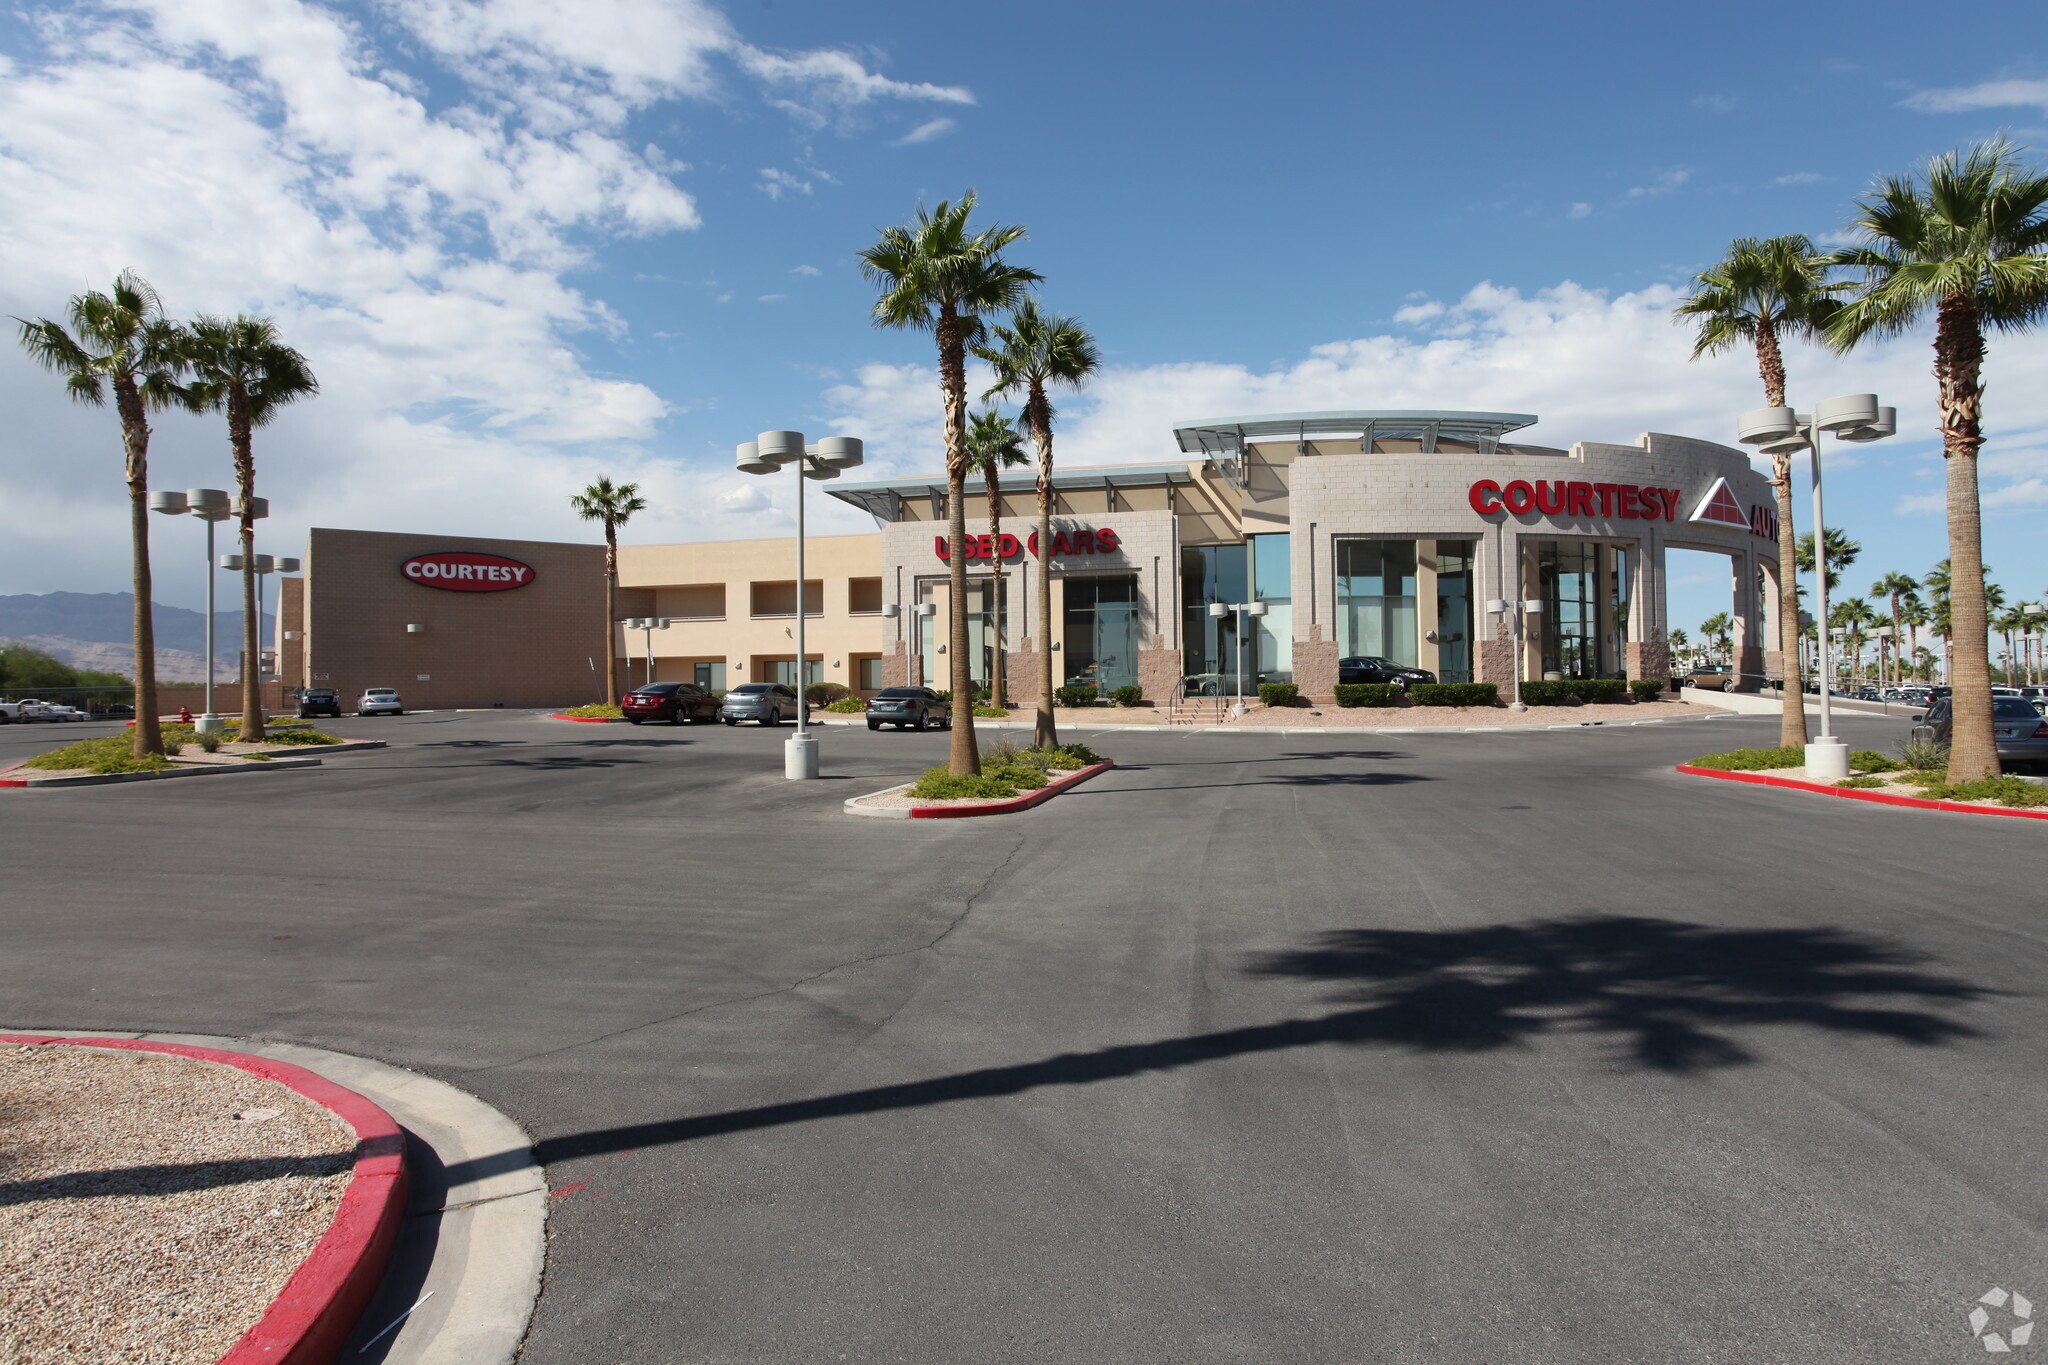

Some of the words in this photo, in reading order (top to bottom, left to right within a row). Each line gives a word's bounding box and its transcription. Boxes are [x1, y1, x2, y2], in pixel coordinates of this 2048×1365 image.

[1469, 479, 1680, 522] COURTESY
[935, 534, 1019, 559] USED
[406, 562, 526, 582] COURTESY
